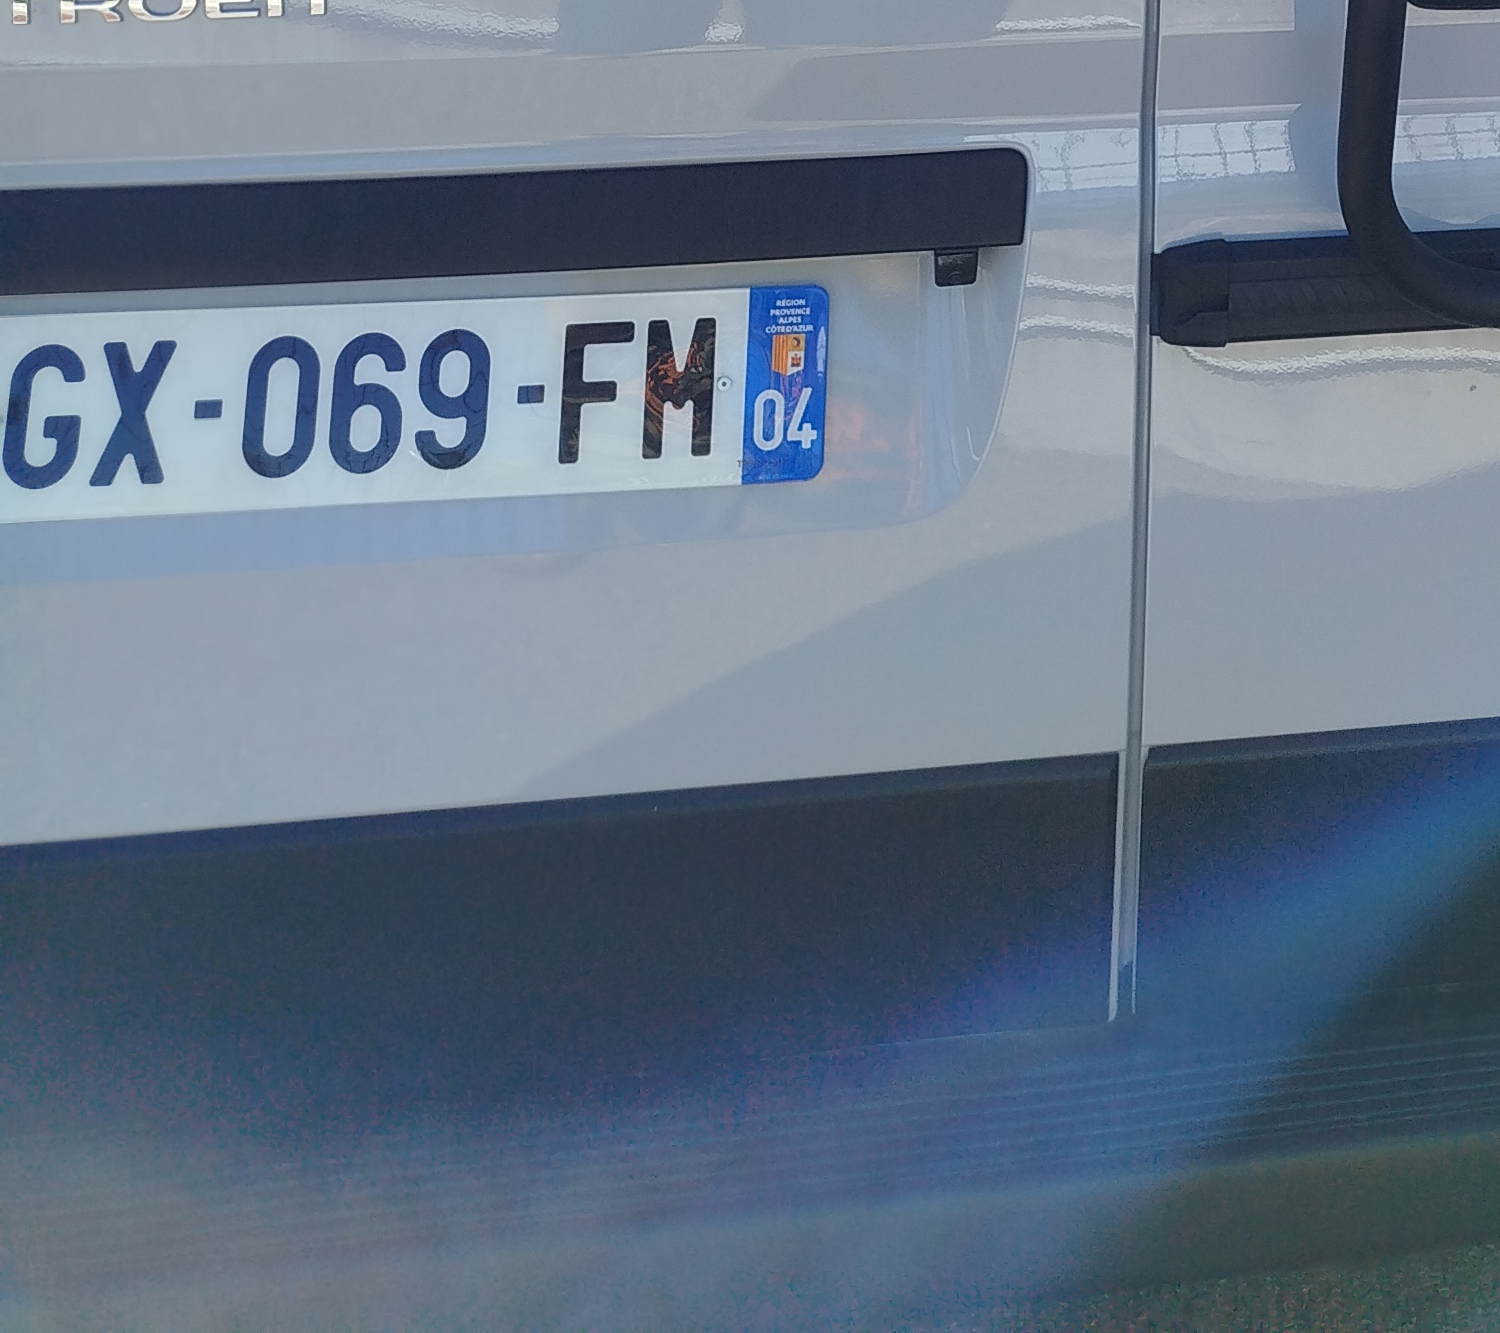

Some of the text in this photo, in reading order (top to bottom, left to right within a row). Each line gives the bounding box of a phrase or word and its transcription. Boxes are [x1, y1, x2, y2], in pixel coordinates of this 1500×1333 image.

[769, 307, 811, 316] PROVENCE
[778, 316, 802, 324] ALPES
[753, 387, 818, 451] 04
